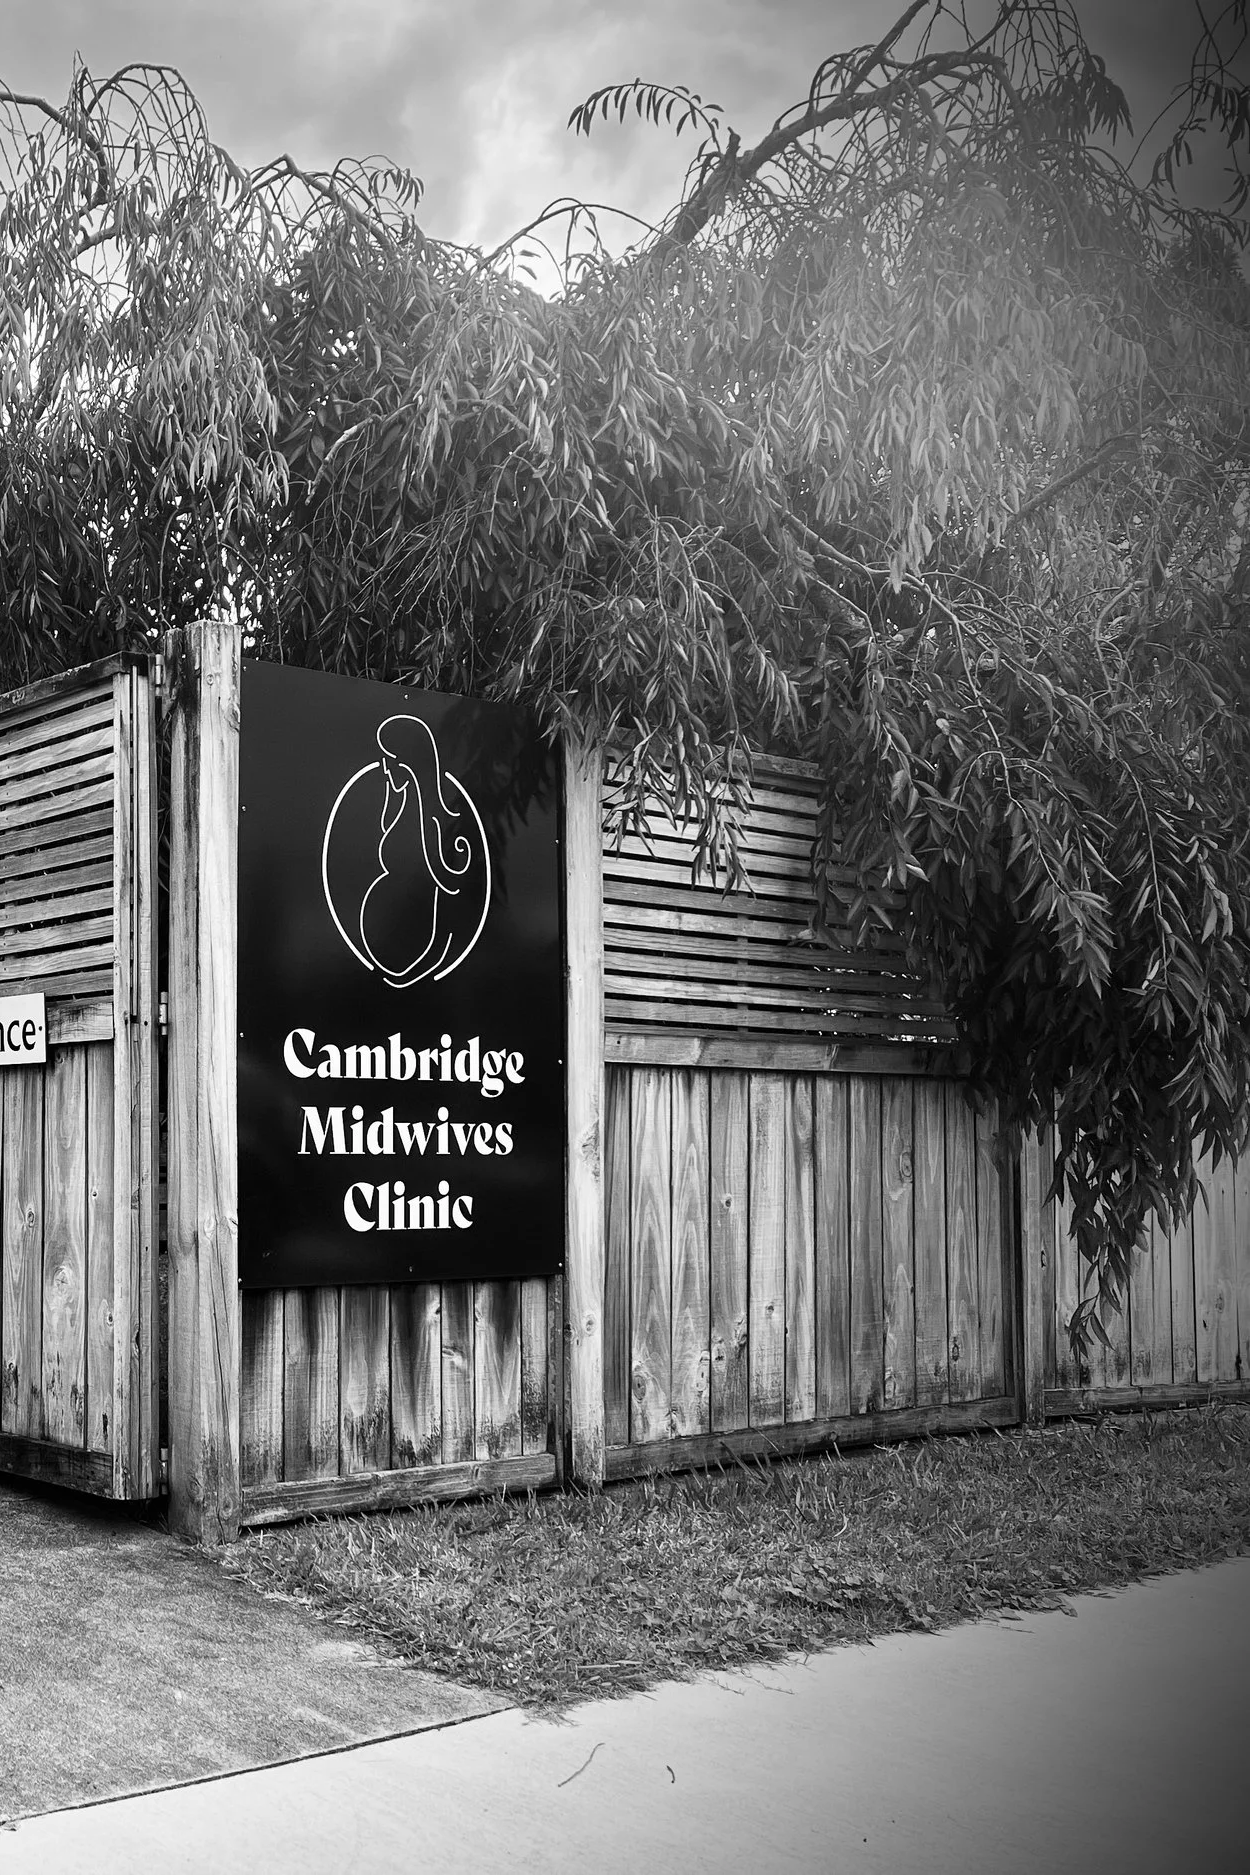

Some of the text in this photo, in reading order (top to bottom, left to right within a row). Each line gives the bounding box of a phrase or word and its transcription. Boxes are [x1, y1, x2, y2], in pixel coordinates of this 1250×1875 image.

[283, 1027, 526, 1099] Cambridge
[297, 1106, 514, 1156] Midwives
[343, 1179, 474, 1233] Clinic
